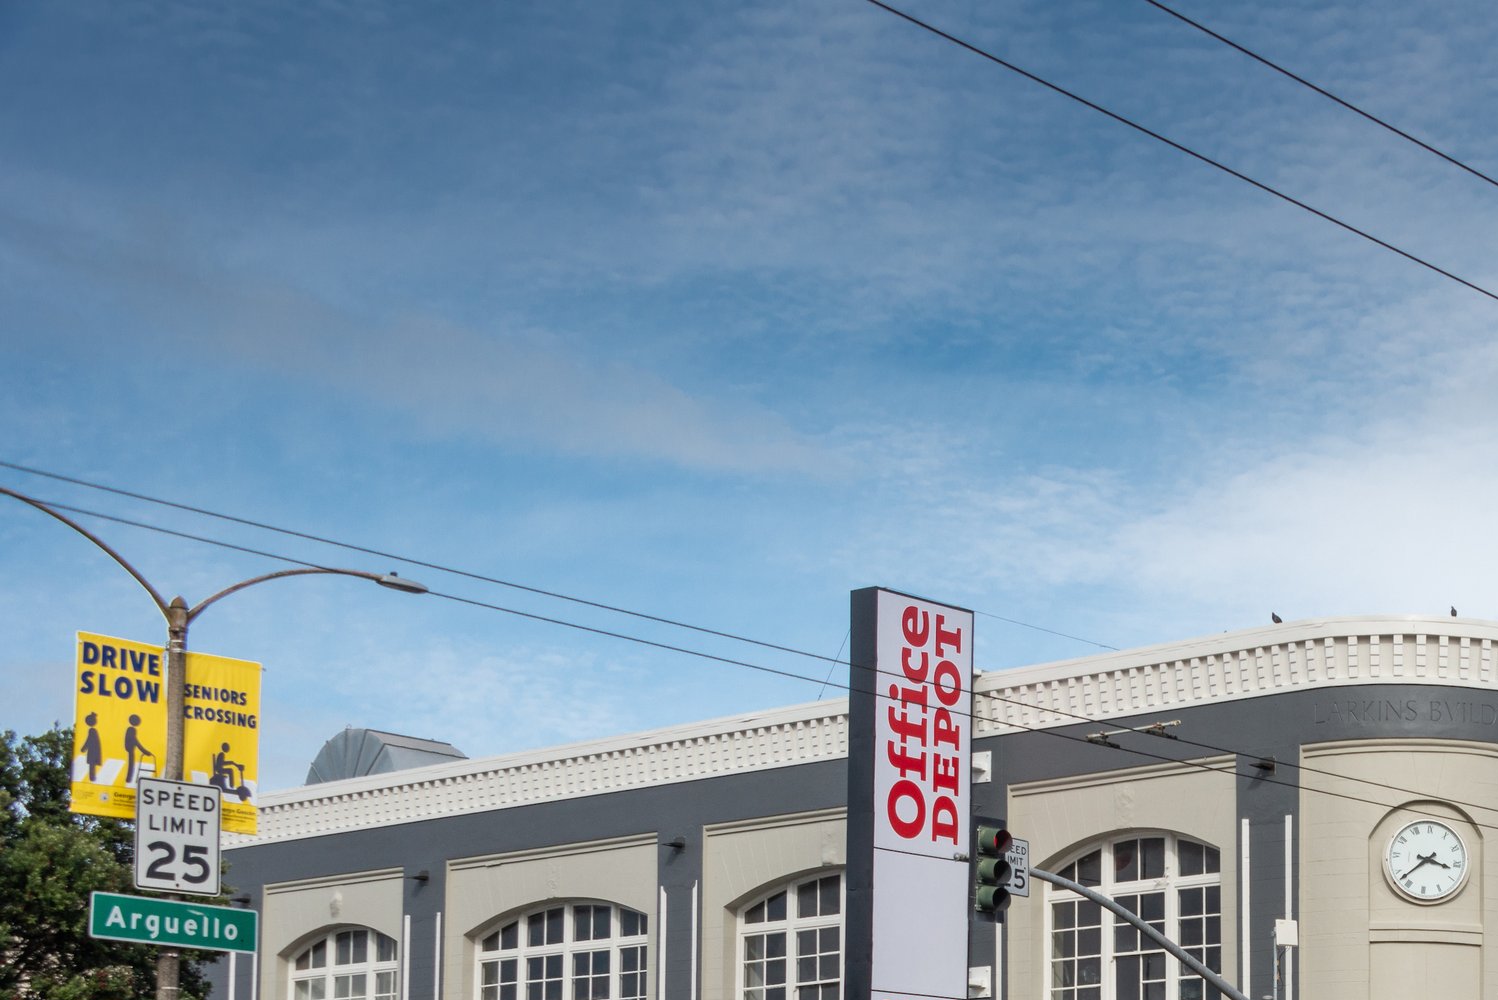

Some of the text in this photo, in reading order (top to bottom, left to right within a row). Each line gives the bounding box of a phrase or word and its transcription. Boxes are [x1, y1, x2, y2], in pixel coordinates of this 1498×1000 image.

[82, 641, 161, 677] DRIVE
[80, 671, 160, 704] SLOW
[184, 683, 248, 706] SENIORS
[184, 705, 257, 729] CROSSING
[887, 605, 930, 839] Office
[1314, 699, 1418, 725] LARKINS
[931, 613, 962, 846] DEPOT
[143, 788, 216, 813] SPEED
[149, 814, 208, 836] LIMIT
[145, 840, 210, 884] 25
[1007, 855, 1024, 867] IMIT
[1010, 844, 1027, 856] EED
[105, 905, 238, 939] Arguello
